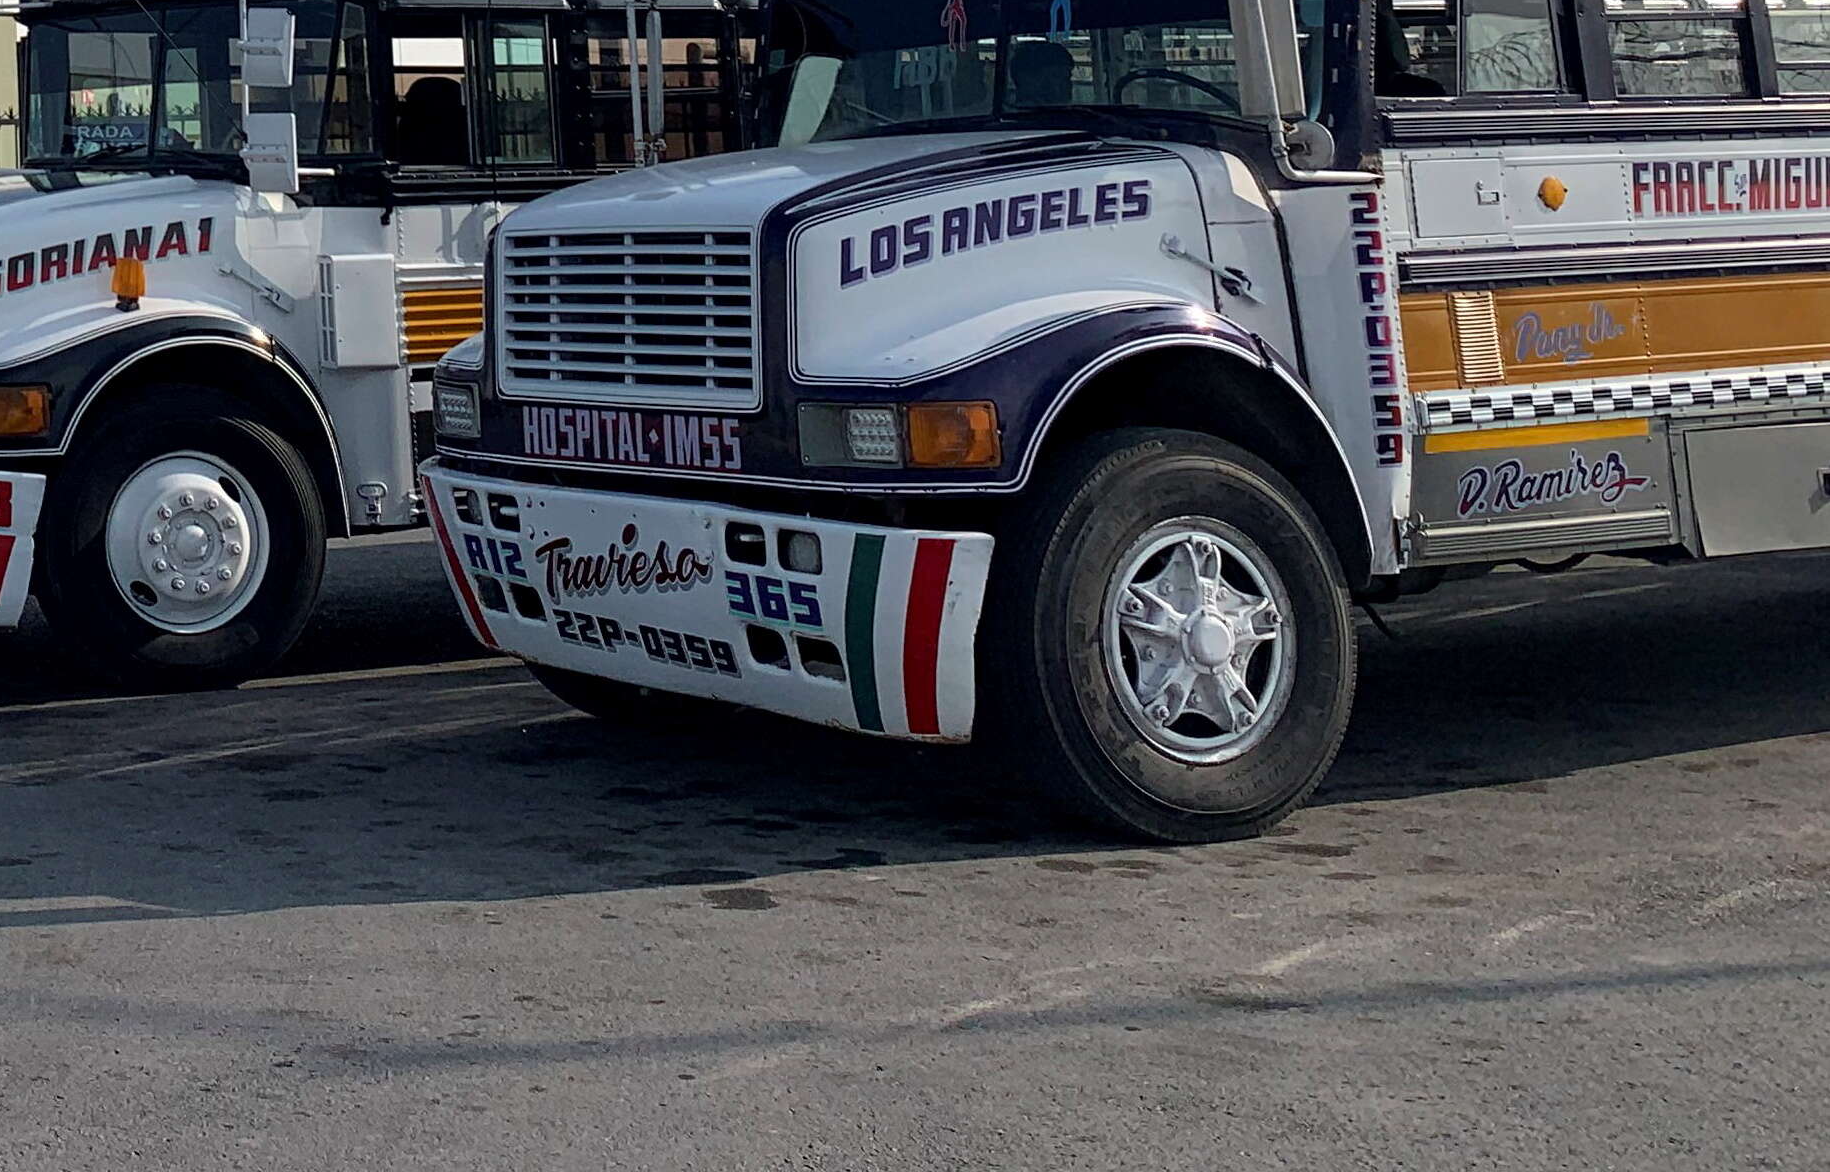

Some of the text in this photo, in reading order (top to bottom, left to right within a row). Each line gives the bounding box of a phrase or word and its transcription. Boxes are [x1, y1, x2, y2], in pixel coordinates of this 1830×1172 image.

[1749, 157, 1830, 212] MIGU
[840, 179, 1152, 289] LOS ANGELES
[522, 406, 741, 470] HOSPITAL IMSS
[536, 523, 715, 605] Travieso
[725, 570, 823, 631] 365
[551, 608, 743, 679] 22P-0359
